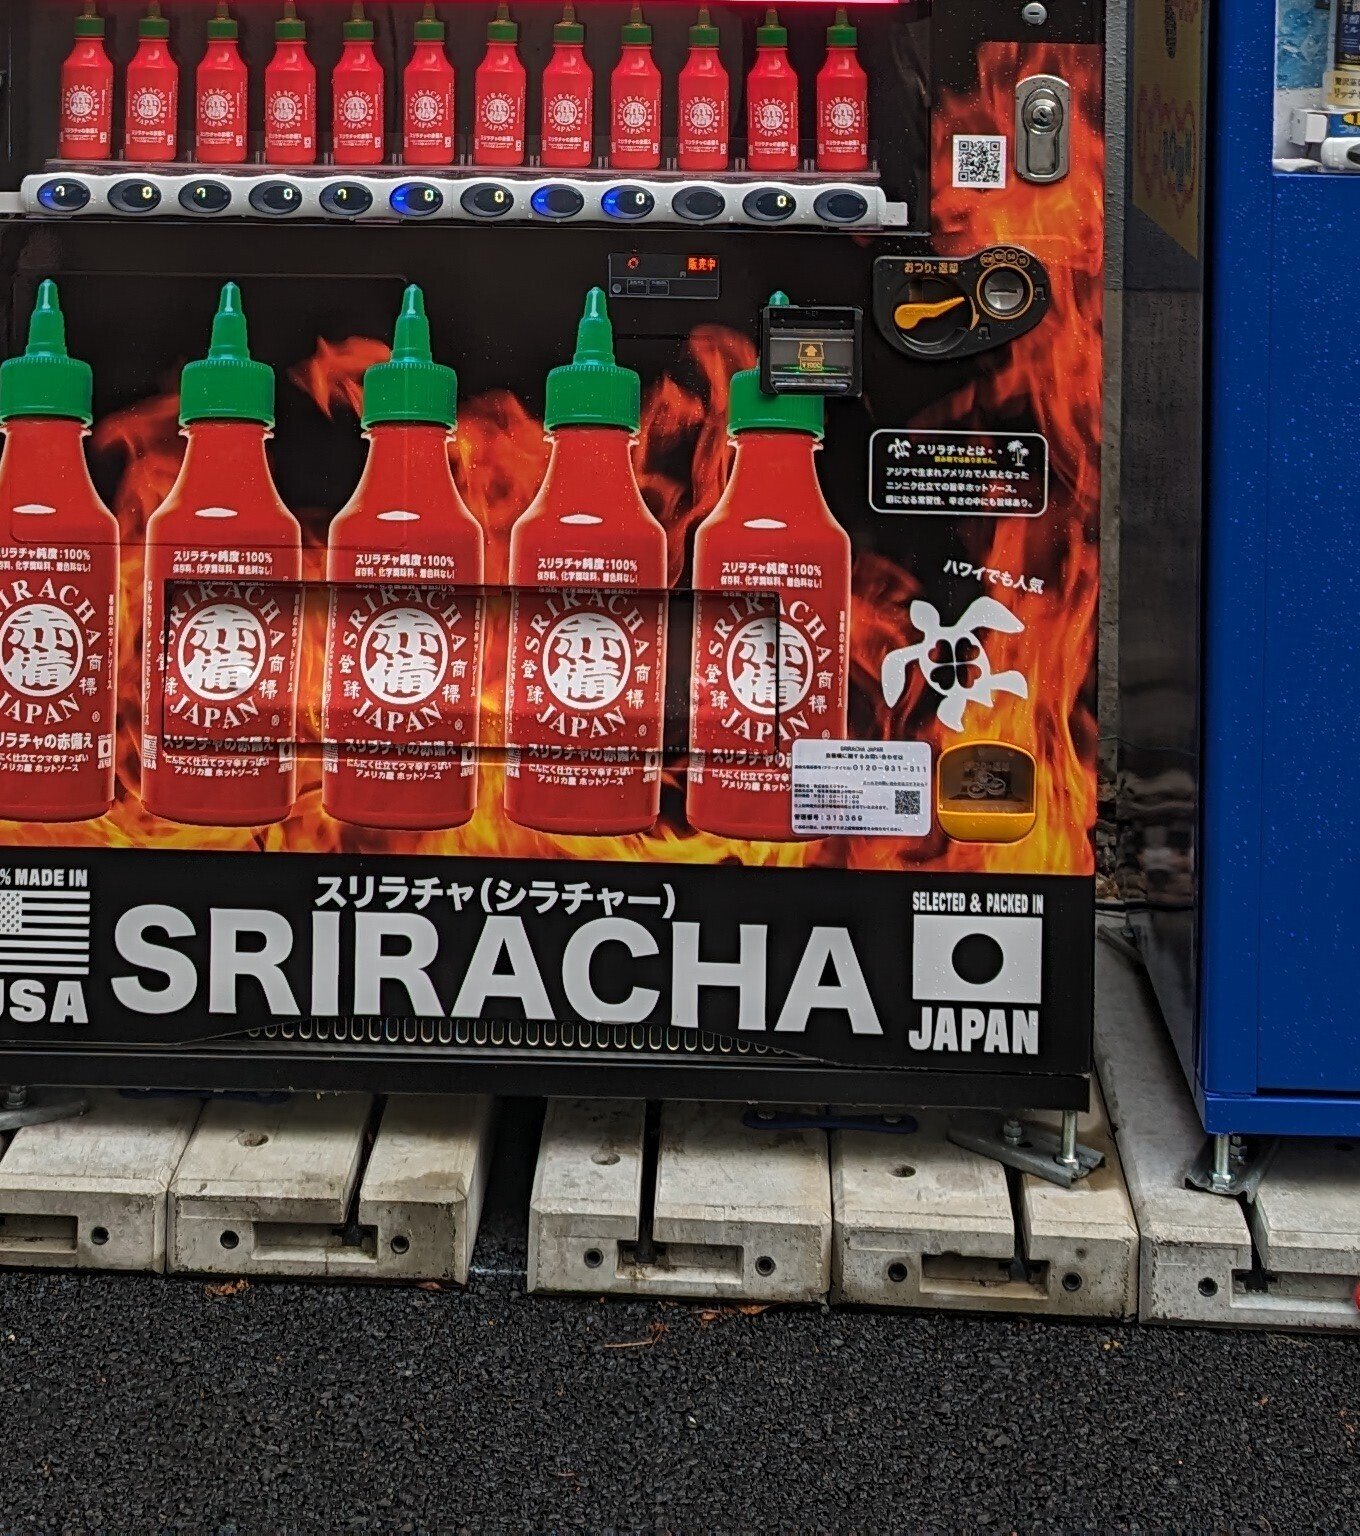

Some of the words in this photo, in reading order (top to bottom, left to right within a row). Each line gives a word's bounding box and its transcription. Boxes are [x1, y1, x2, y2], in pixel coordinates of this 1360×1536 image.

[688, 257, 716, 271] 販売中
[943, 557, 1045, 596] ハワイでも人気
[342, 583, 469, 651] SRIRACHA
[524, 589, 651, 658] SRIRACHA
[170, 695, 259, 729] JAPAN
[352, 697, 444, 733] JAPAN
[537, 704, 628, 740] JAPAN
[721, 710, 811, 744] JAPAN
[14, 868, 65, 886] MADE
[68, 868, 88, 887] IN
[912, 891, 966, 912] SELECTED
[969, 892, 982, 913] &
[986, 893, 1029, 914] PACKED
[1032, 894, 1045, 914] IN
[110, 903, 884, 1036] SRIRACHA
[908, 1006, 1039, 1055] JAPAN
